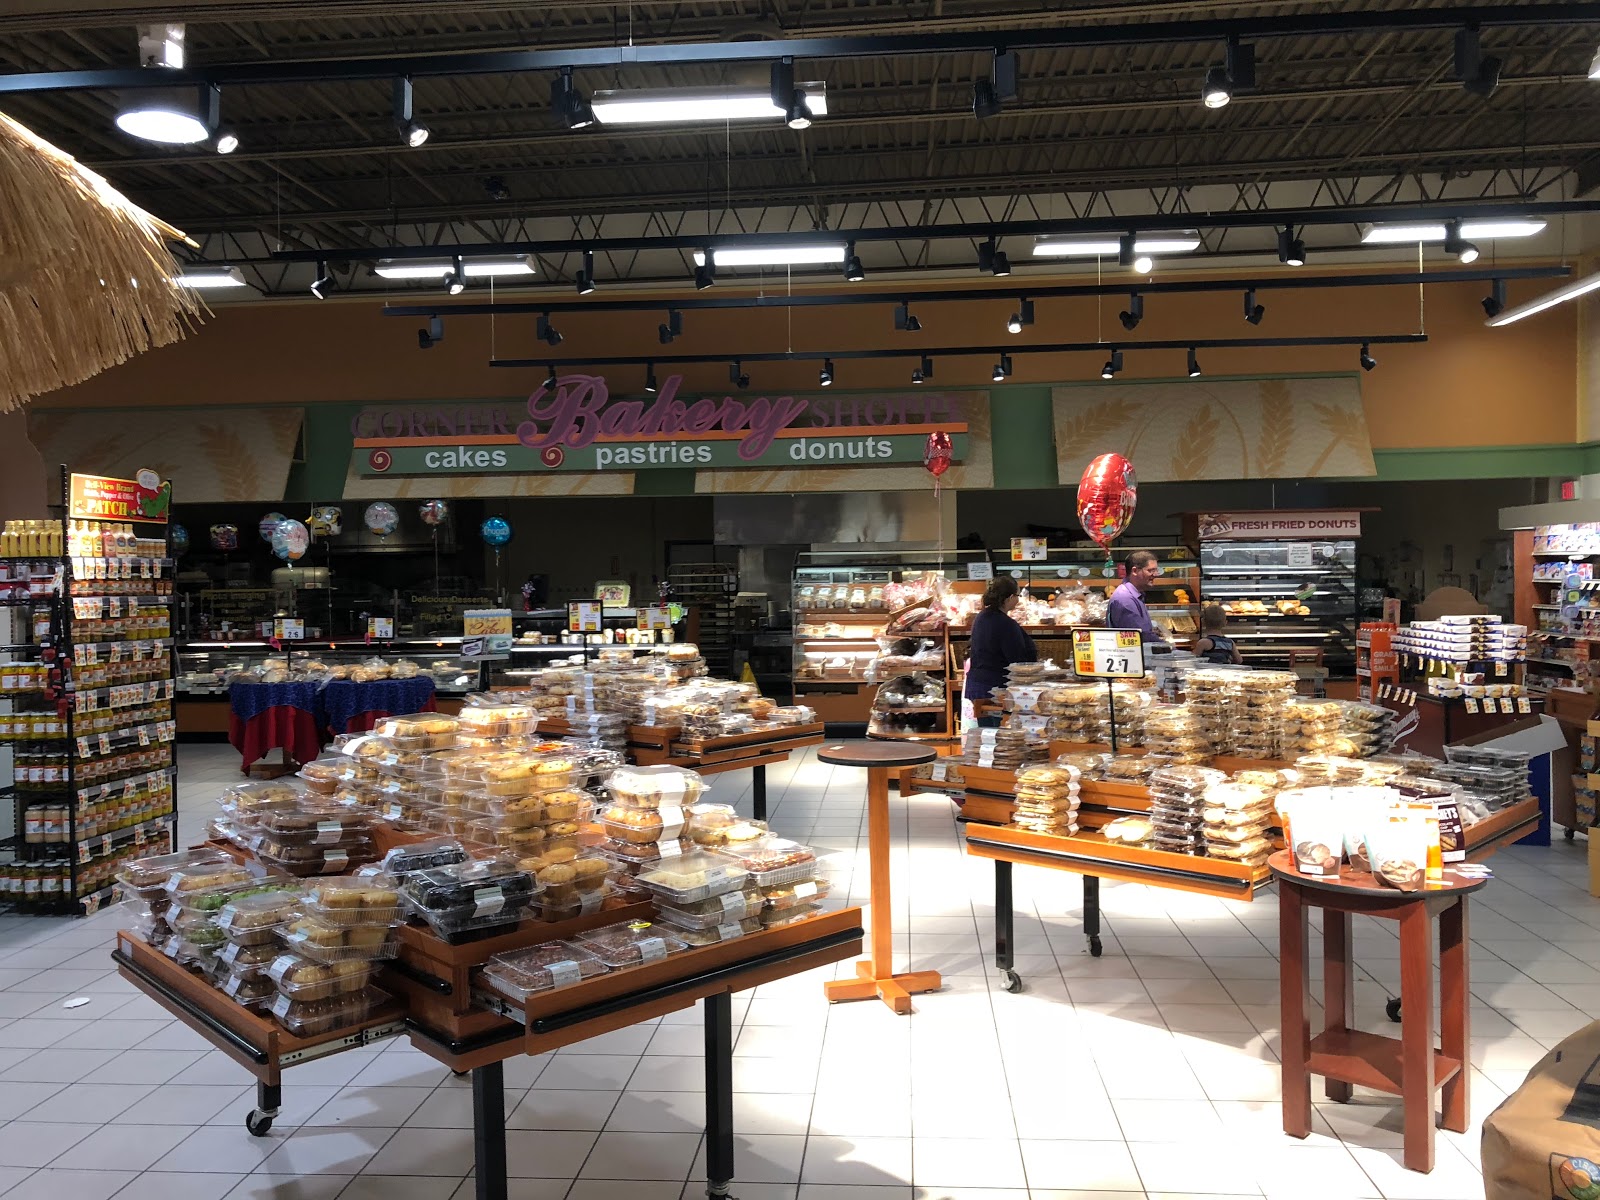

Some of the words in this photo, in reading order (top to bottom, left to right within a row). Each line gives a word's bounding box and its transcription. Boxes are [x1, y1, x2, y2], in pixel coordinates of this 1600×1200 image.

[351, 406, 510, 438] CORNER
[516, 374, 809, 461] Bakery
[811, 395, 964, 429] SHOPPE
[425, 446, 507, 469] cakes
[596, 440, 712, 470] pastries
[789, 436, 893, 460] donuts
[86, 499, 128, 516] PATCH
[1231, 520, 1269, 530] FRESH
[1272, 520, 1306, 530] FRIED
[1308, 519, 1357, 529] DONUTS
[469, 621, 506, 636] Cakes
[1106, 658, 1115, 673] 2
